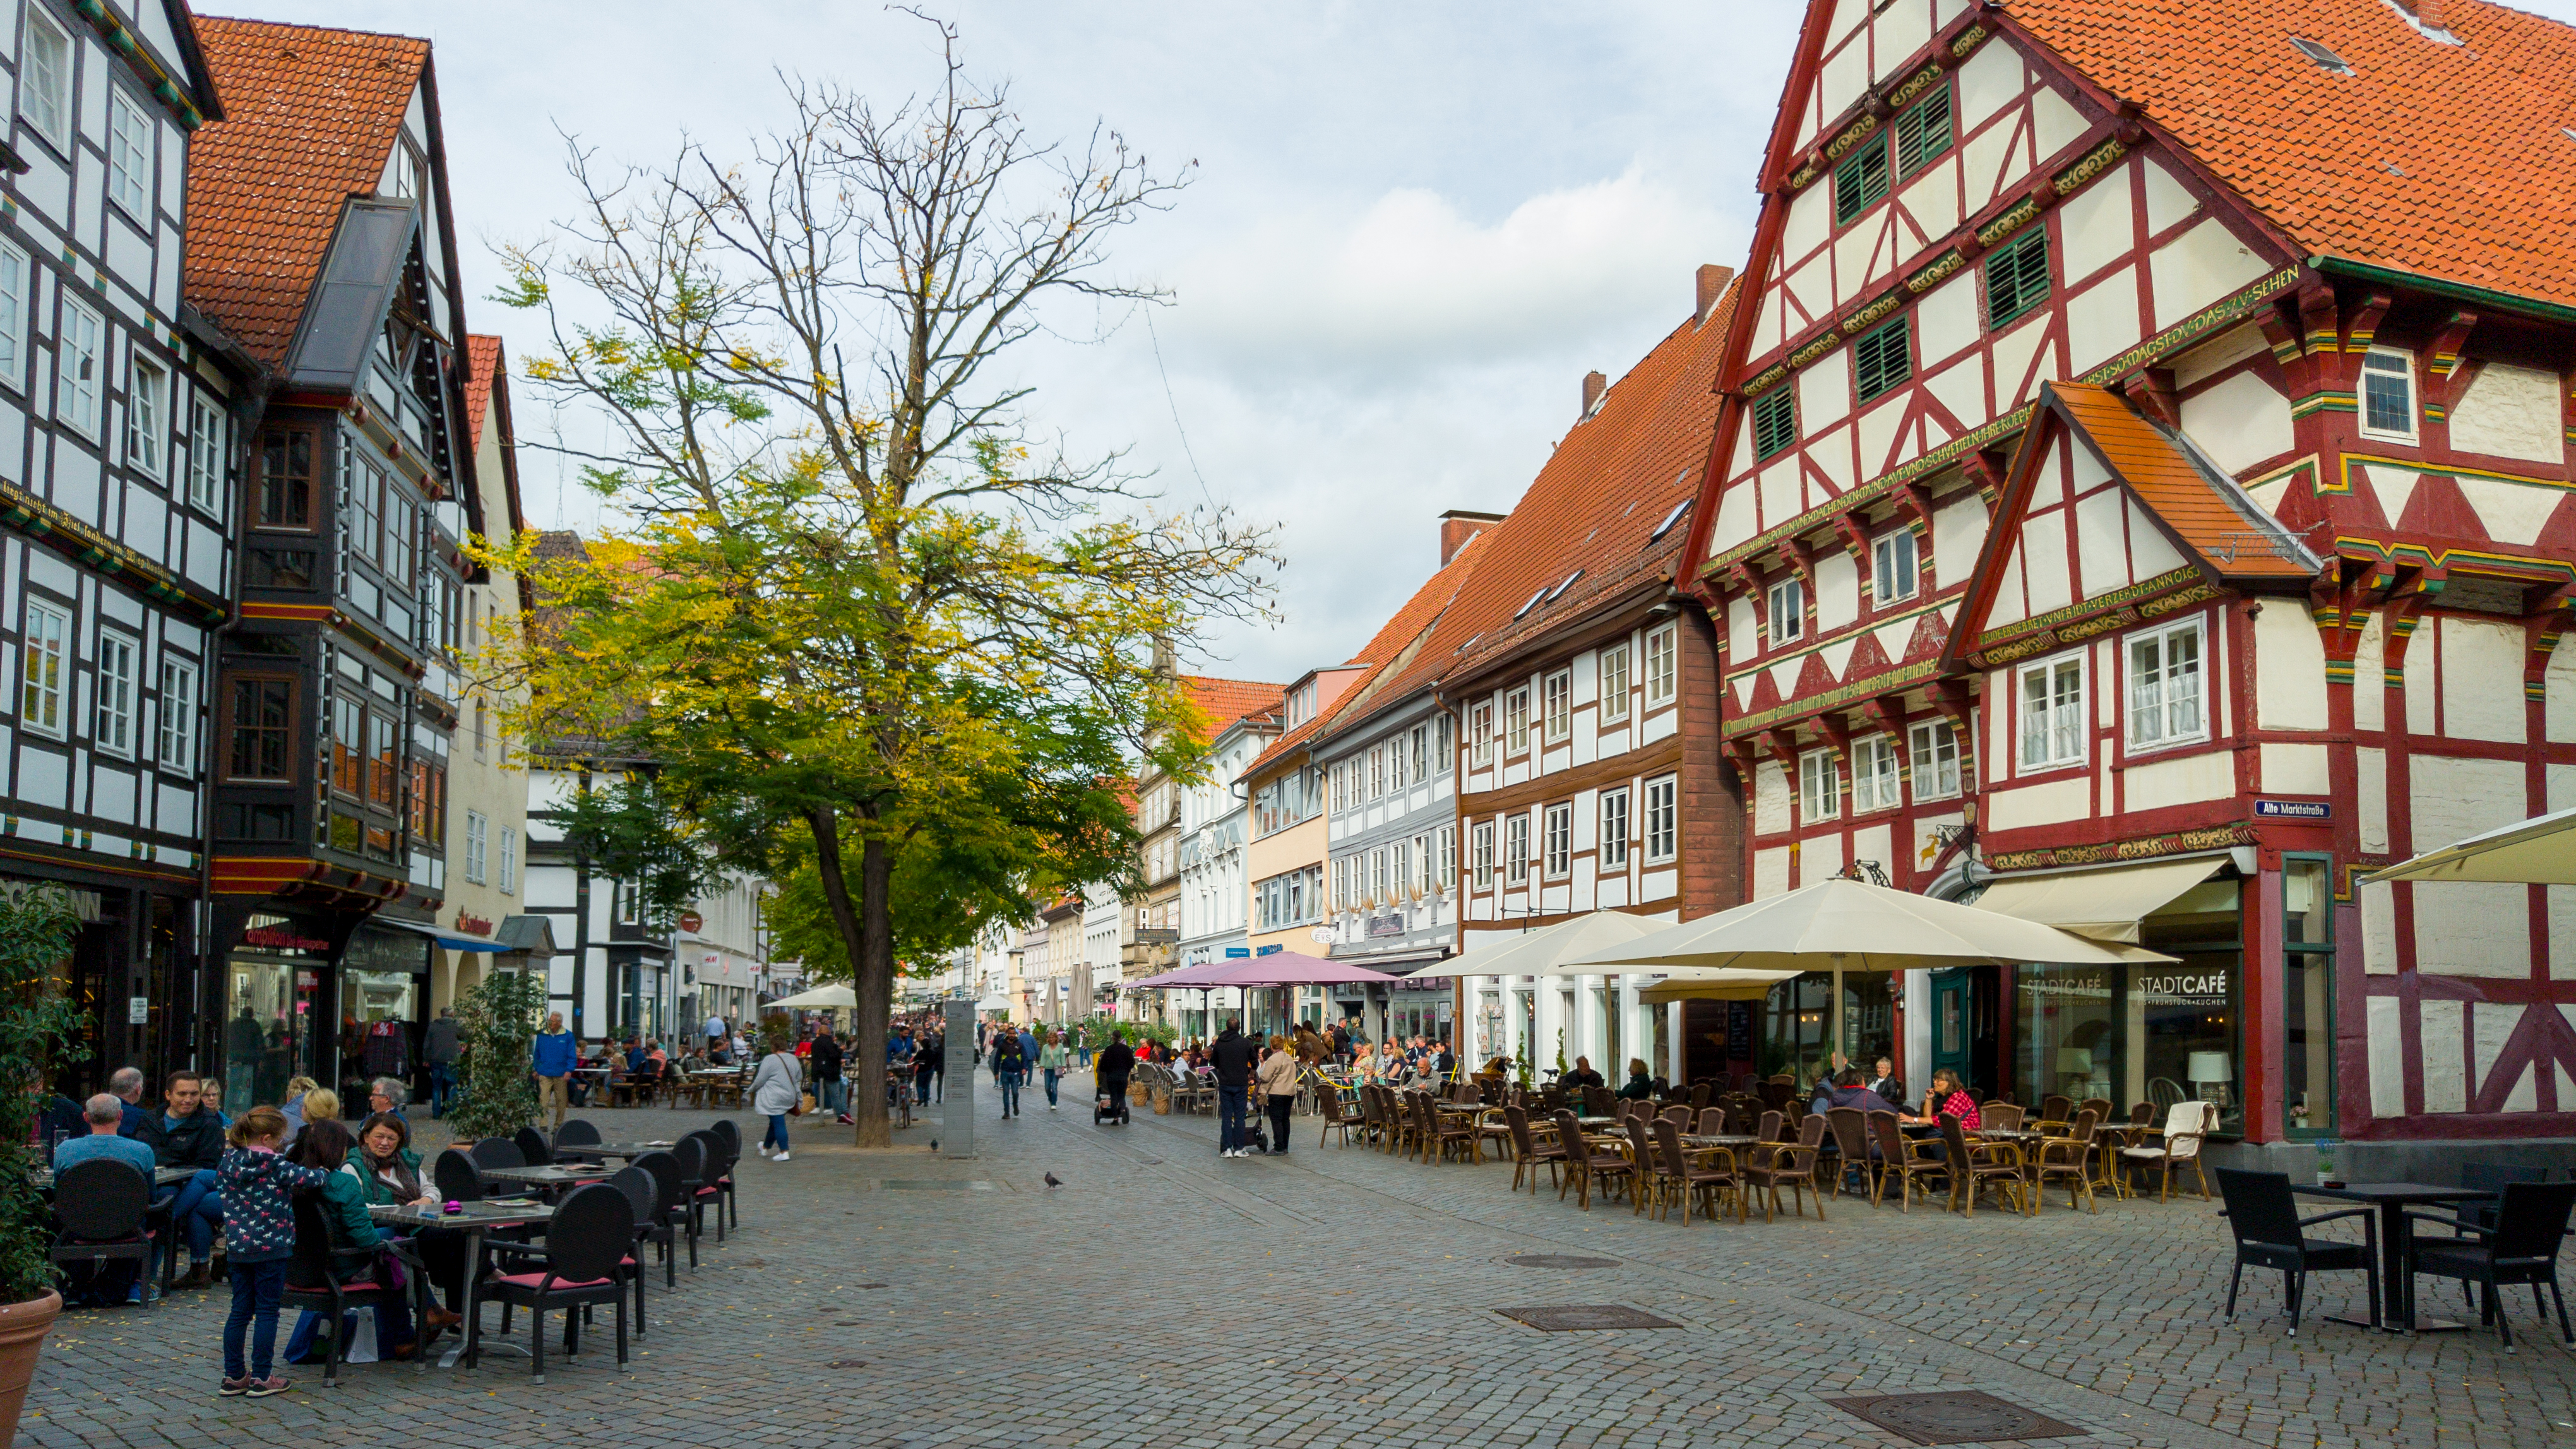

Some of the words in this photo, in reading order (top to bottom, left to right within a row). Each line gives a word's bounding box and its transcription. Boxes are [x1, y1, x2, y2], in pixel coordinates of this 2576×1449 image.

[2194, 304, 2226, 331] DAS
[2252, 264, 2299, 301] SEHEN
[25, 495, 45, 514] nicht
[2263, 802, 2278, 813] Alte
[2281, 803, 2323, 815] Marktstraße
[2027, 974, 2101, 995] STADTCAFÉ
[2138, 970, 2226, 994] STADTCAFÉ
